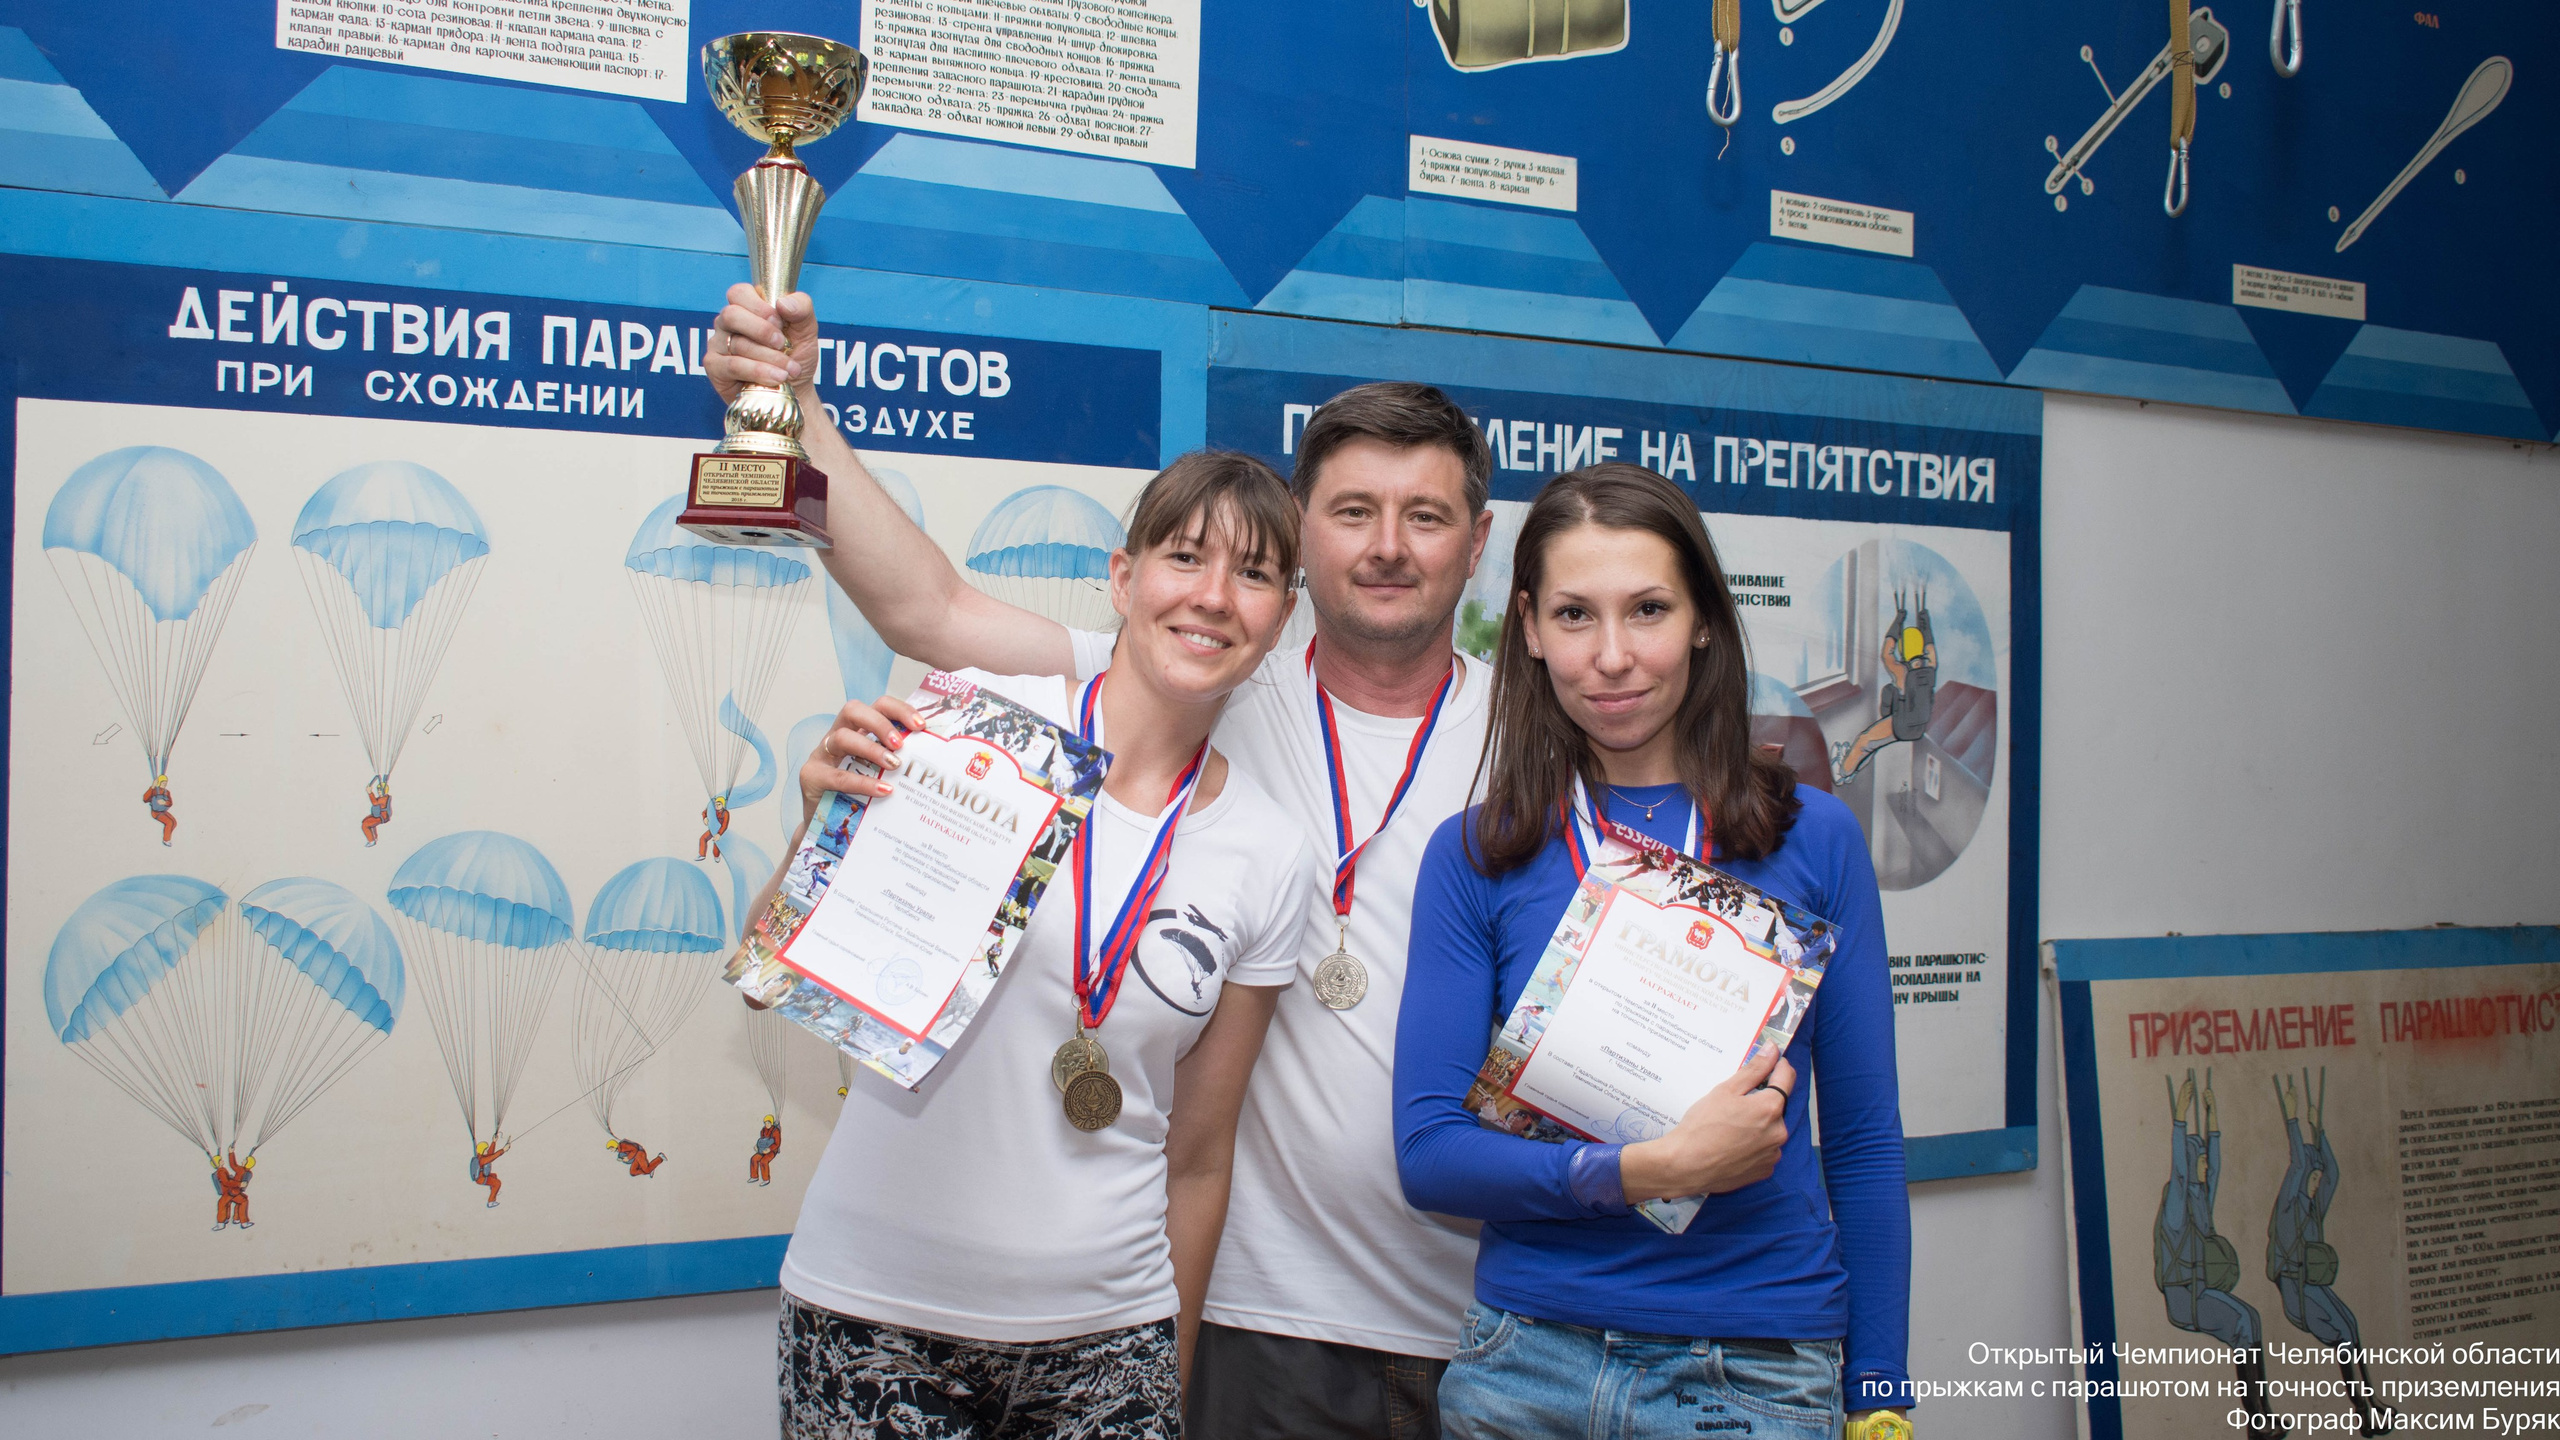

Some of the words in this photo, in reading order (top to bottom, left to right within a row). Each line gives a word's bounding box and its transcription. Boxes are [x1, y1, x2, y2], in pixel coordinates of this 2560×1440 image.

[552, 0, 612, 17] крепления
[926, 2, 934, 11] с
[452, 0, 514, 18] контровки
[518, 9, 550, 23] петли
[656, 29, 664, 39] с
[2414, 11, 2440, 29] ФАЛ
[290, 7, 334, 22] карман
[542, 41, 586, 57] подтяга
[290, 22, 332, 36] клапан
[450, 41, 470, 55] для
[550, 28, 596, 43] кармана
[344, 43, 404, 61] ранцевый
[874, 34, 926, 50] изогнутая
[930, 40, 948, 54] для
[930, 29, 980, 45] изогнутая
[984, 35, 1002, 49] для
[1006, 41, 1064, 59] свободных
[932, 56, 986, 72] вытяжного
[872, 61, 928, 78] крепления
[932, 70, 986, 86] запасного
[1108, 96, 1146, 109] грудной
[872, 87, 922, 103] поясного
[986, 117, 1024, 131] ножной
[1114, 136, 1148, 149] правый
[169, 281, 511, 361] ДЕЙСТВИЯ
[542, 315, 1011, 397] ПАРАТИСТОВ
[217, 360, 313, 397] ПРИ
[365, 370, 644, 419] СХОЖДЕНИИ
[1284, 404, 1623, 472] ПЛЕНИЕ
[1640, 430, 1696, 482] НА
[1714, 436, 1996, 504] ПРЕПЯТСТВИЯ
[719, 462, 728, 471] II
[732, 463, 766, 472] МЕСТО
[901, 758, 1020, 836] ГРАМОТА
[919, 814, 971, 846] НАГРАЖДАЕТ
[1617, 920, 1752, 1004] ГРАМОТА
[1892, 971, 1962, 986] ПОПАДАНИИ
[1966, 971, 1981, 982] НА
[1639, 976, 1699, 1011] НАГРАЖДАЕТ
[1656, 1006, 1675, 1019] место
[1620, 1012, 1647, 1029] точность
[1647, 1027, 1686, 1051] приземления
[1654, 1023, 1689, 1045] парашютом
[1659, 1016, 1698, 1041] Челябинской
[1698, 1038, 1723, 1054] области
[2128, 1003, 2357, 1059] ПРИЗЕМЛЕНИЕ
[1626, 1041, 1651, 1059] команду
[1614, 1061, 1647, 1082] Челябинск
[1090, 1117, 1098, 1129] 3
[1673, 1388, 1699, 1408] You
[1702, 1404, 1725, 1413] are
[1695, 1418, 1752, 1435] amazing
